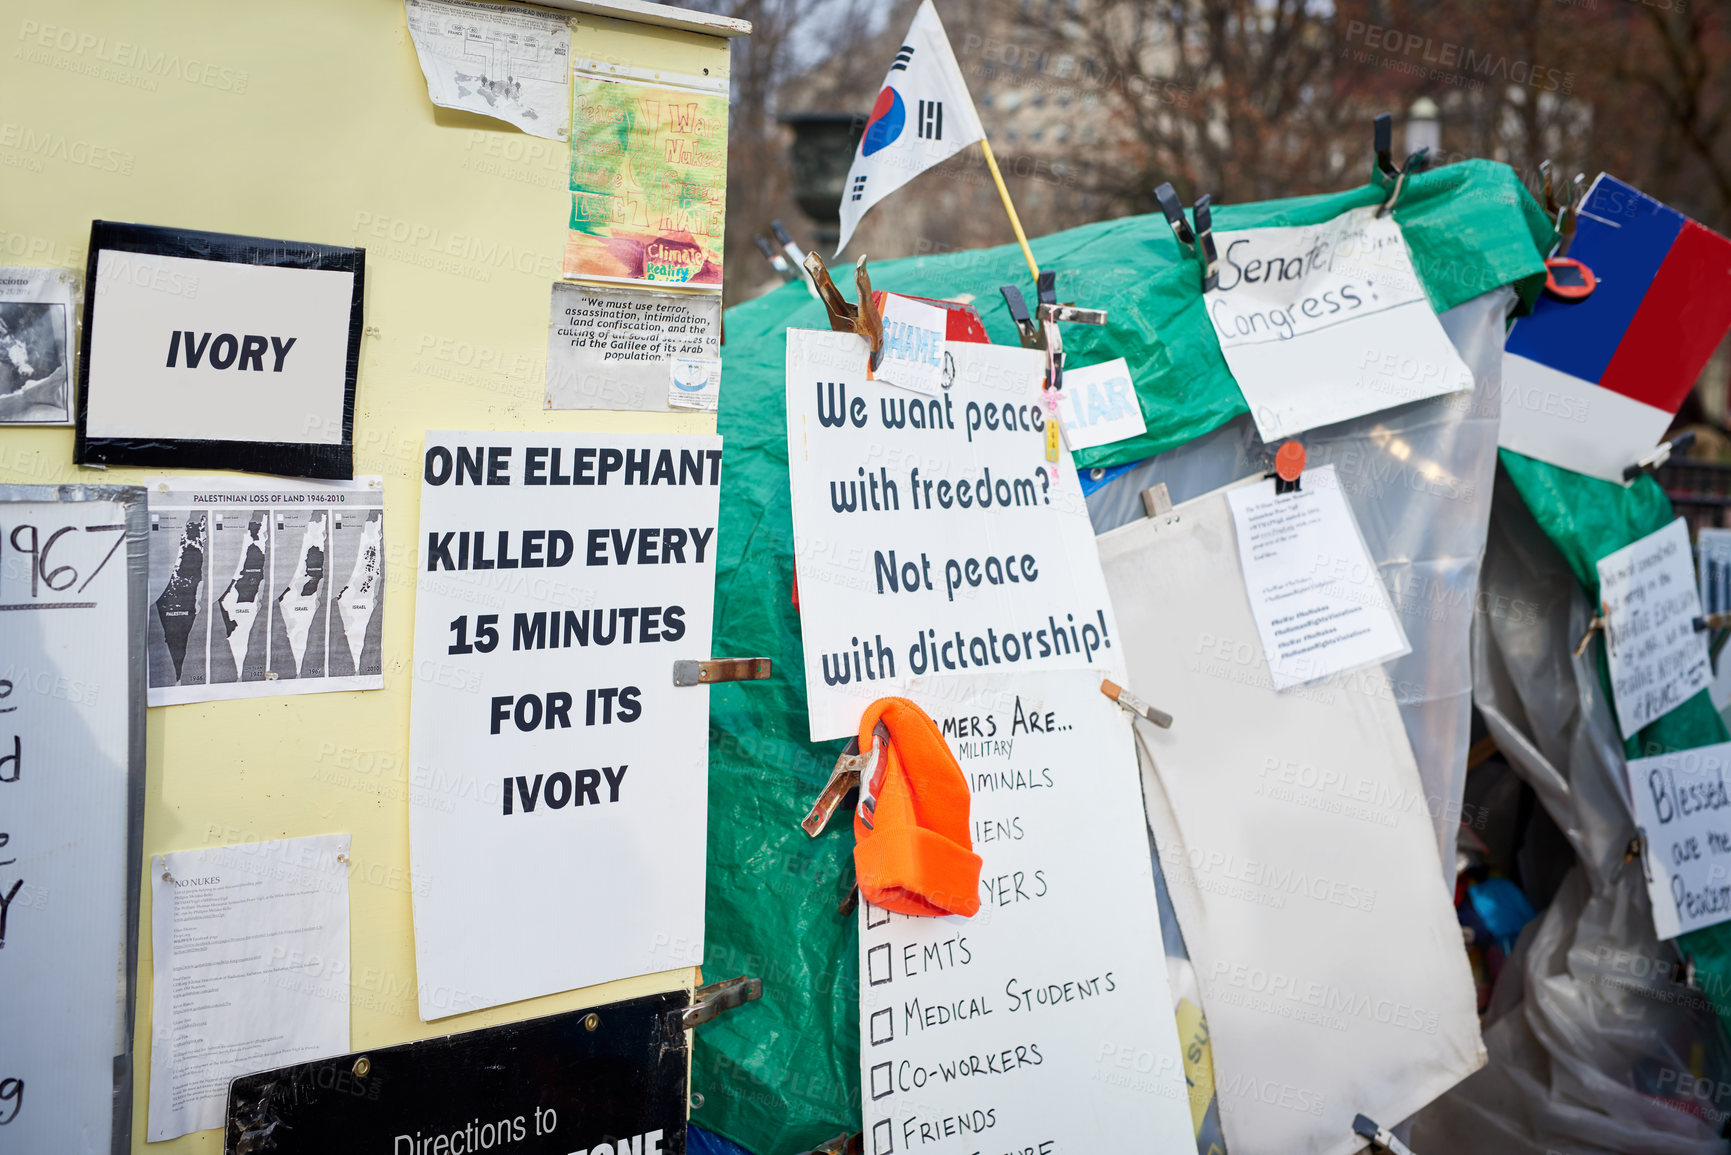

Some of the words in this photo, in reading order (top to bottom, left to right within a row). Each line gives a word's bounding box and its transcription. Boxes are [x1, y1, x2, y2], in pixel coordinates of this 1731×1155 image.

[507, 7, 536, 16] WARHEAD
[668, 102, 722, 139] War
[664, 138, 723, 168] Nukes
[661, 169, 725, 201] Greed
[647, 243, 703, 266] Climate
[565, 308, 640, 321] assassination,
[644, 313, 710, 326] intimidation,
[570, 317, 594, 327] land
[597, 319, 664, 333] confiscation,
[667, 324, 686, 334] and
[689, 325, 706, 334] the
[606, 300, 632, 310] must
[635, 302, 653, 311] use
[656, 303, 690, 315] terror,
[1212, 280, 1380, 340] Congress:
[166, 330, 297, 373] IVORY
[571, 338, 586, 347] rid
[589, 339, 607, 348] the
[610, 339, 647, 350] Galilee
[650, 343, 661, 353] of
[664, 343, 677, 353] its
[680, 344, 704, 354] Arab
[706, 336, 717, 345] to
[883, 315, 942, 368] SHAME
[816, 381, 868, 428] We
[879, 393, 955, 429] want
[967, 400, 1045, 443] peace
[424, 445, 513, 487] ONE
[523, 446, 722, 487] ELEPHANT
[193, 494, 247, 503] PALESTINIAN
[249, 494, 269, 503] LOSS
[270, 494, 283, 503] OF
[284, 494, 305, 503] LAND
[307, 494, 345, 503] 1946-2010
[830, 466, 900, 514] with
[911, 466, 1051, 509] freedom?
[0, 524, 127, 598] 967
[427, 529, 575, 572] KILLED
[586, 526, 715, 567] EVERY
[874, 549, 934, 595] Not
[944, 553, 1039, 602] peace
[447, 613, 500, 656] 15
[512, 605, 686, 652] MINUTES
[821, 633, 896, 687] with
[908, 609, 1112, 676] dictatorship!
[490, 691, 572, 735] FOR
[585, 685, 643, 726] ITS
[937, 714, 997, 739] MERS
[959, 738, 1014, 761] MILITARY
[502, 764, 629, 816] IVORY
[1649, 768, 1730, 824] Blessed
[975, 816, 1025, 843] IENS
[1671, 836, 1701, 866] are
[175, 879, 189, 888] NO
[190, 876, 221, 886] NUKES
[982, 869, 1048, 907] YERS
[904, 996, 994, 1037] MEDICAL
[1004, 971, 1116, 1013] STUDENTS
[898, 1043, 1044, 1093] CO-WORKERS
[393, 1113, 526, 1155] Directions
[533, 1105, 558, 1134] to
[903, 1107, 997, 1151] FRIENDS
